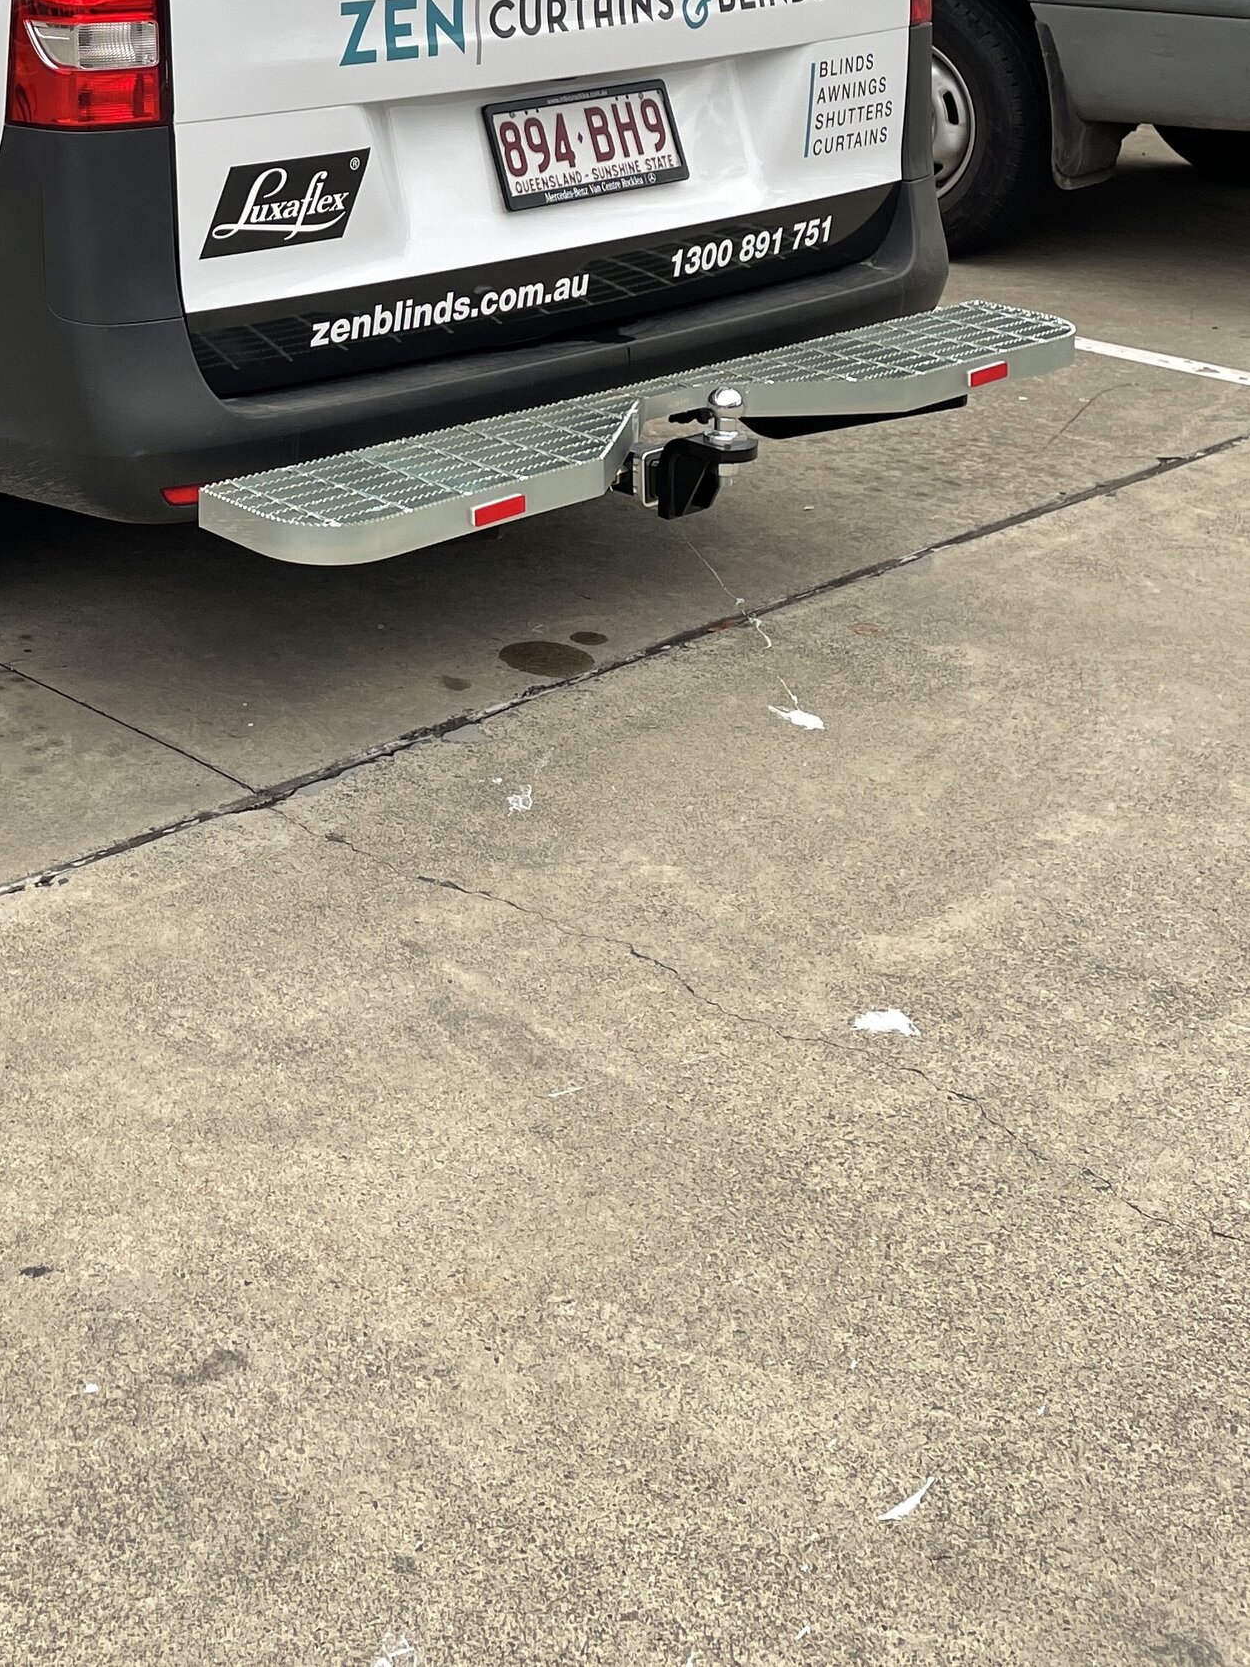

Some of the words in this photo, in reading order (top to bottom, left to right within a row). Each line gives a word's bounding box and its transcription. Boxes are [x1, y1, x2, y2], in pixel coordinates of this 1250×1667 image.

[819, 53, 875, 78] BLINDS
[816, 76, 887, 105] AWNINGS
[814, 100, 894, 130] SHUTTERS
[812, 126, 888, 156] CURTAINS
[515, 170, 583, 194] QUEENSLAND
[591, 157, 642, 181] SUNSHINE
[644, 153, 674, 172] STATE
[212, 168, 349, 240] Luxaflex
[545, 186, 590, 203] Mercedes-Benz
[589, 183, 602, 194] Van
[601, 178, 622, 193] Centre
[671, 238, 733, 277] 1300
[739, 227, 783, 263] 891
[792, 216, 832, 250] 751
[310, 274, 589, 348] zenblinds.com.au
